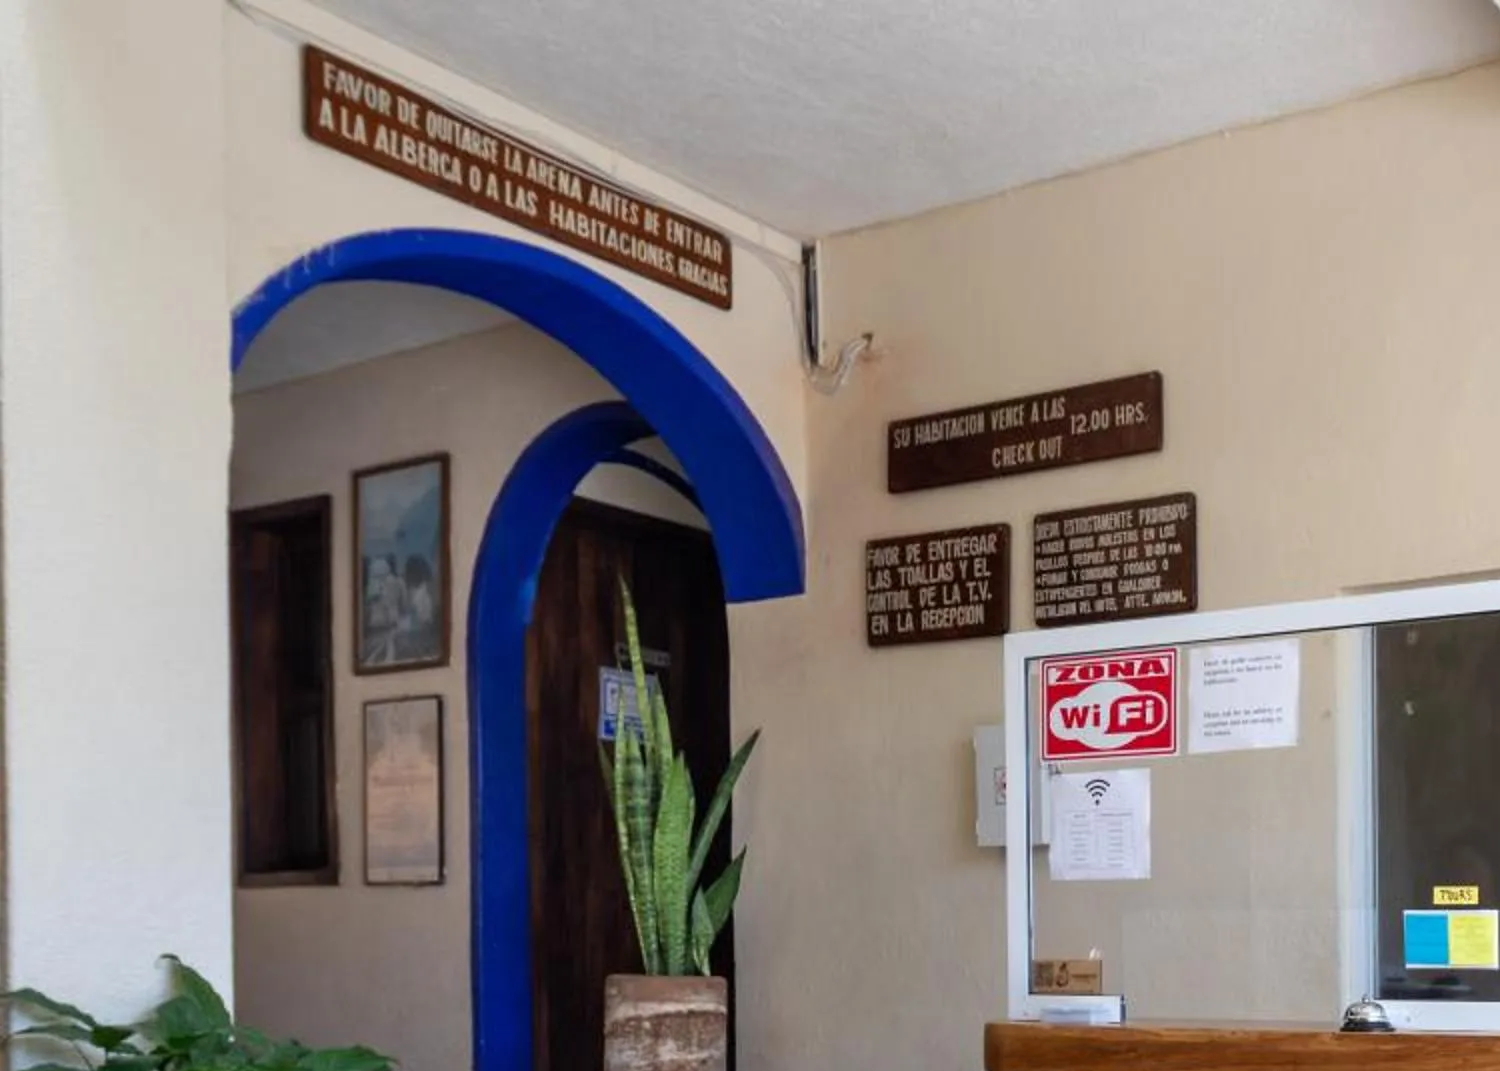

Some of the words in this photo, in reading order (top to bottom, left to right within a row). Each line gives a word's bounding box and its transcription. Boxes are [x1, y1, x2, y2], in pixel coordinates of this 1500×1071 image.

[323, 61, 390, 116] FAVOR
[397, 96, 420, 129] DE
[426, 110, 499, 164] QUITARSE
[504, 146, 523, 176] LA
[527, 158, 583, 203] ARENA
[588, 183, 639, 226] ANTES
[644, 208, 660, 236] DE
[666, 218, 723, 264] ENTRAR
[319, 98, 335, 132] A
[340, 107, 368, 145] LA
[374, 125, 462, 186] ALBERCA
[469, 166, 482, 193] O
[486, 173, 499, 201] A
[504, 181, 538, 218] LAS
[678, 256, 728, 296] GRACIAS
[894, 428, 910, 449] SU
[915, 411, 985, 446] HABITACION
[991, 404, 1025, 430] VENCE
[1031, 402, 1040, 422] A
[1043, 397, 1066, 420] LAS
[992, 442, 1035, 469] CHECK
[1039, 436, 1063, 461] OUT
[1160, 523, 1176, 538] LOS
[868, 546, 899, 567] FAVOR
[905, 543, 921, 564] DE
[928, 533, 997, 561] ENTREGAR
[868, 569, 891, 591] LAS
[898, 561, 954, 587] TOALLAS
[960, 560, 968, 579] Y
[974, 557, 991, 577] EL
[868, 590, 912, 612] CONTROL
[920, 586, 936, 608] DE
[943, 583, 961, 605] LA
[871, 614, 889, 635] EN
[897, 611, 914, 632] LA
[921, 604, 984, 631] RECEPCION
[1056, 659, 1166, 683] ZONA
